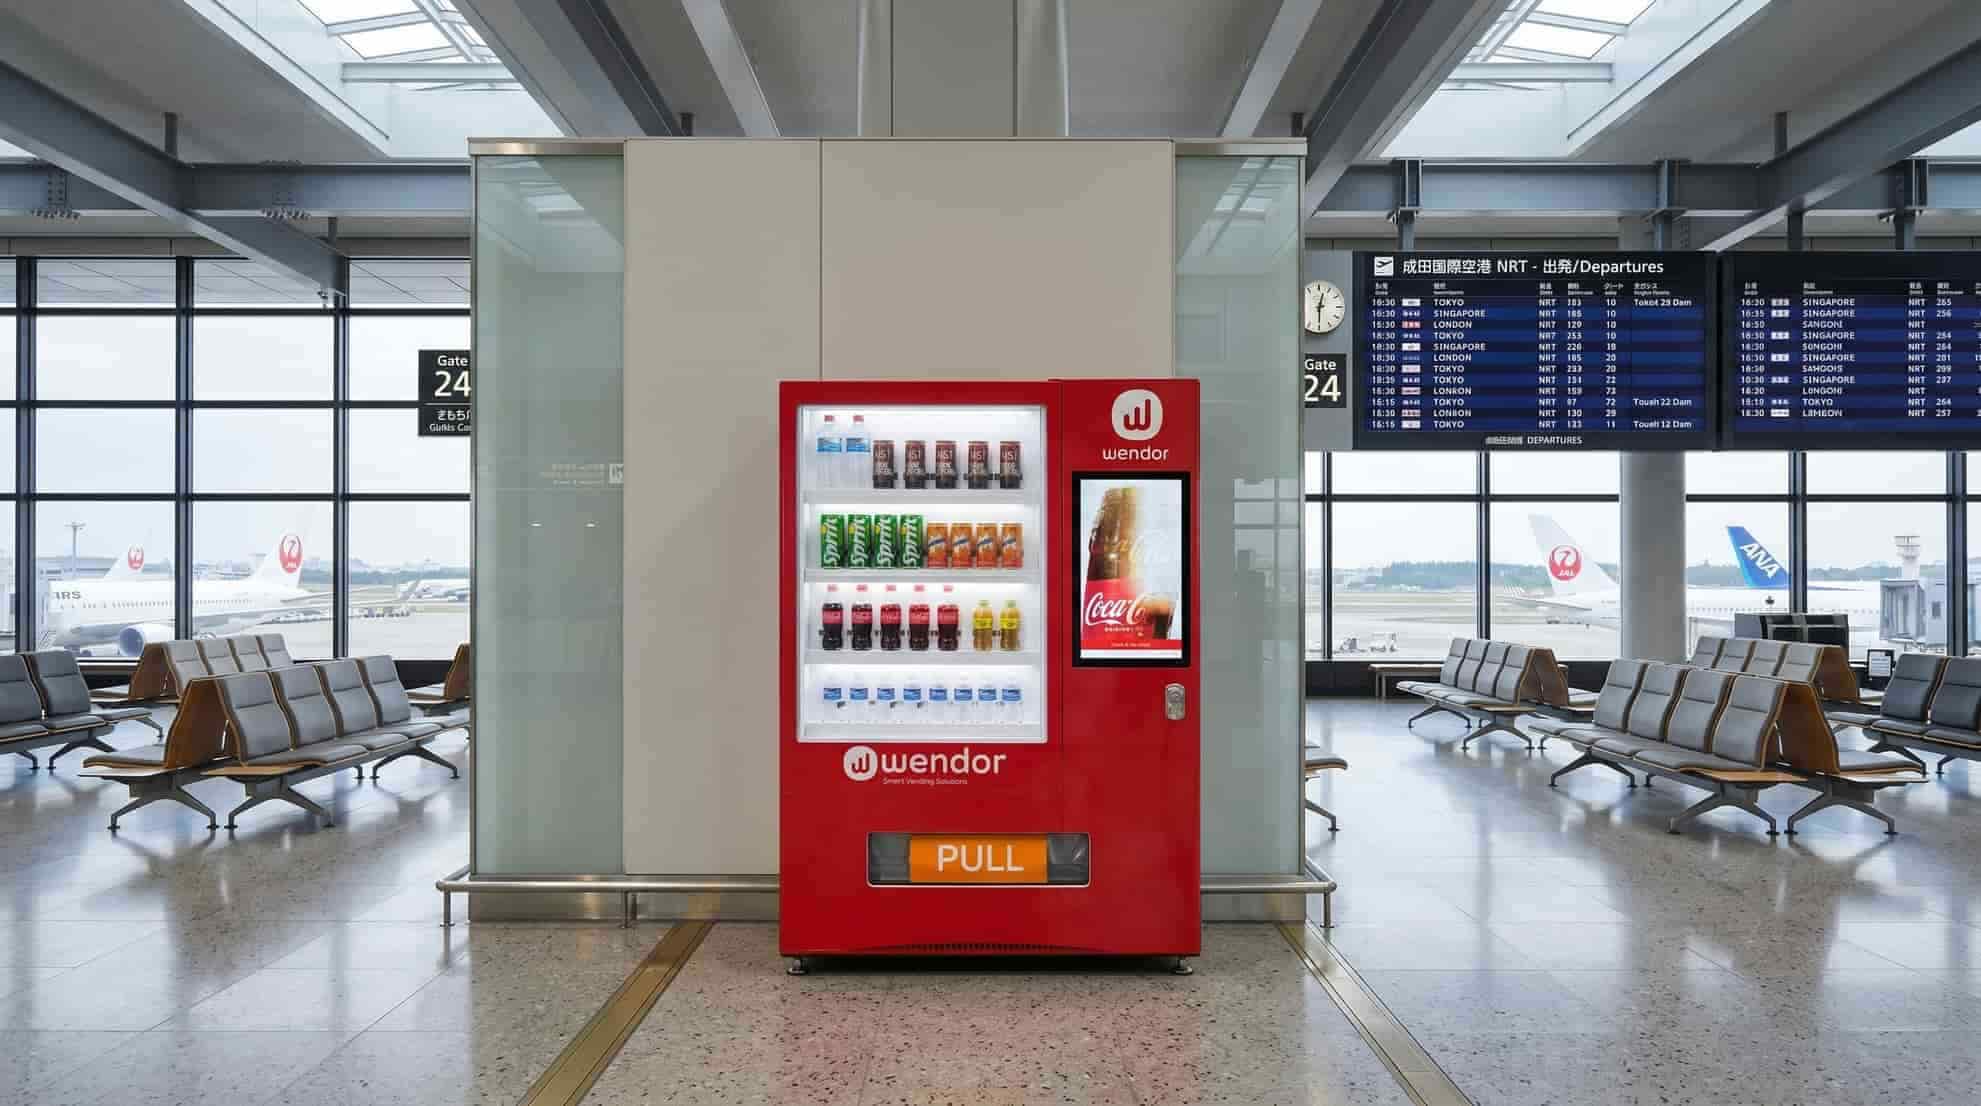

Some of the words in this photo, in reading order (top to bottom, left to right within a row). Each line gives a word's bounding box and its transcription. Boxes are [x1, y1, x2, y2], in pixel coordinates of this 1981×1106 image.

[1498, 260, 1528, 272] NRT
[1544, 259, 1663, 276] 出発/Departures
[438, 355, 468, 367] Gate
[1304, 359, 1337, 371] Gate
[434, 370, 472, 397] 24
[1434, 376, 1464, 384] TOKYO
[1539, 376, 1555, 384] NRT
[1803, 376, 1855, 384] SINGAPORE
[1304, 375, 1341, 402] 24
[1528, 436, 1582, 444] DEPARTURES
[1102, 446, 1168, 461] wendor
[1740, 544, 1780, 578] ANA
[881, 747, 1006, 774] wendor
[883, 777, 904, 785] Smart
[907, 777, 934, 787] Vending
[935, 777, 968, 785] Solutions
[937, 844, 1024, 872] PULL
